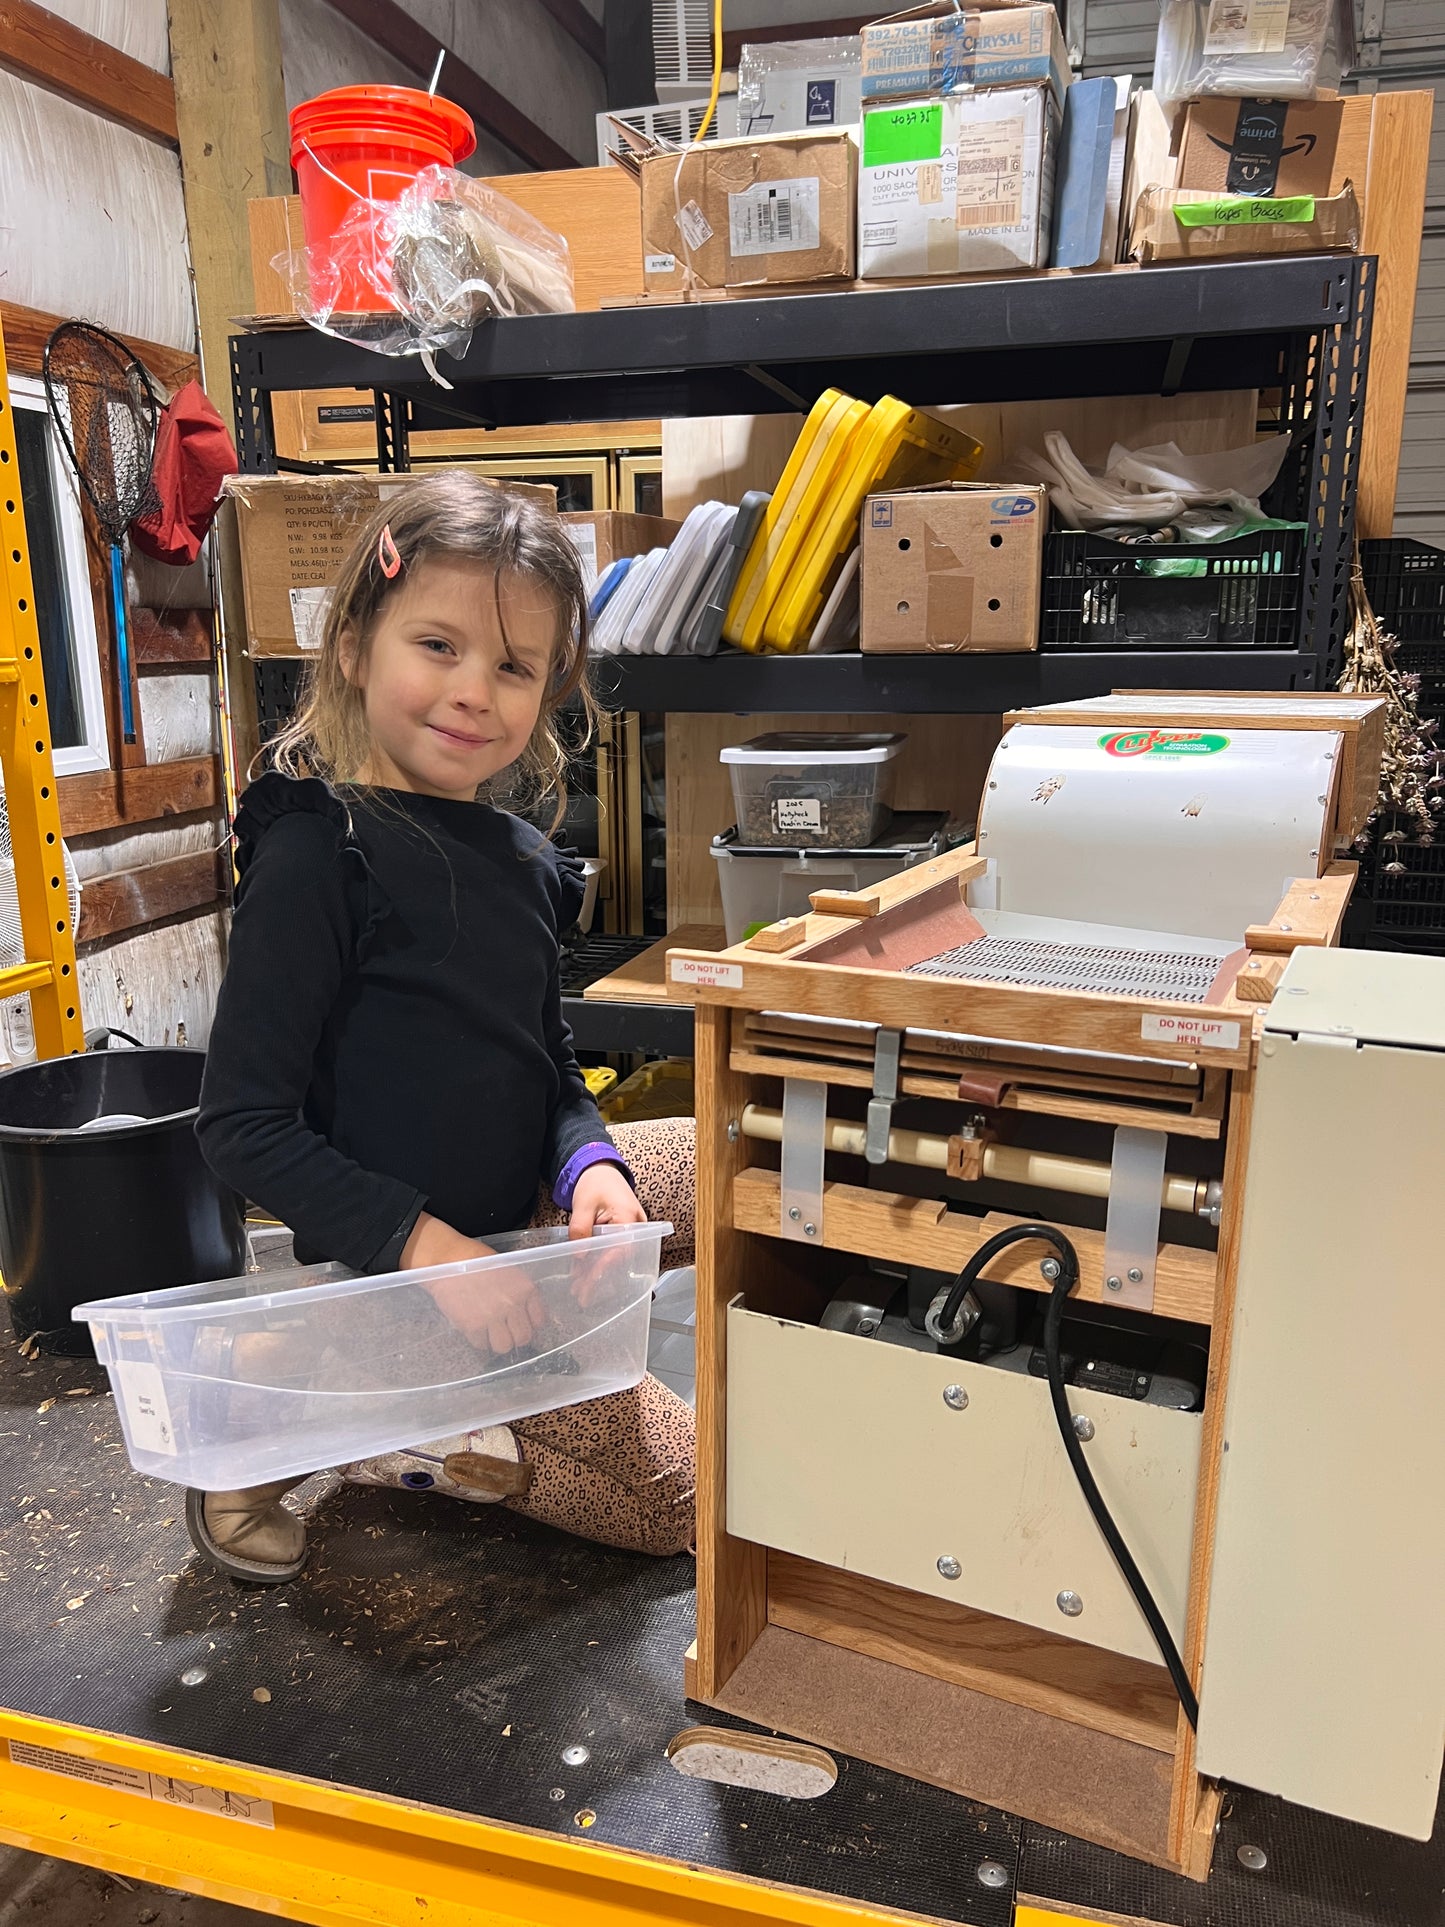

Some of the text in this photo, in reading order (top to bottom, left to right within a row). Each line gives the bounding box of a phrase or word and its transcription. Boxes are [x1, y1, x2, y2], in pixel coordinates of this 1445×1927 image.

[963, 32, 1023, 51] CHRYSAL
[876, 74, 920, 89] PREMIUM
[1004, 63, 1030, 76] CARE
[1240, 127, 1277, 141] prime
[873, 183, 892, 195] 1000
[968, 227, 998, 236] MADE
[1014, 224, 1029, 233] EU
[1105, 730, 1202, 757] CLIPPER
[684, 963, 730, 975] DO NOT LIFT
[697, 976, 716, 985] HERE
[1159, 1019, 1223, 1033] DO NOT LIFT
[1177, 1034, 1203, 1045] HERE
